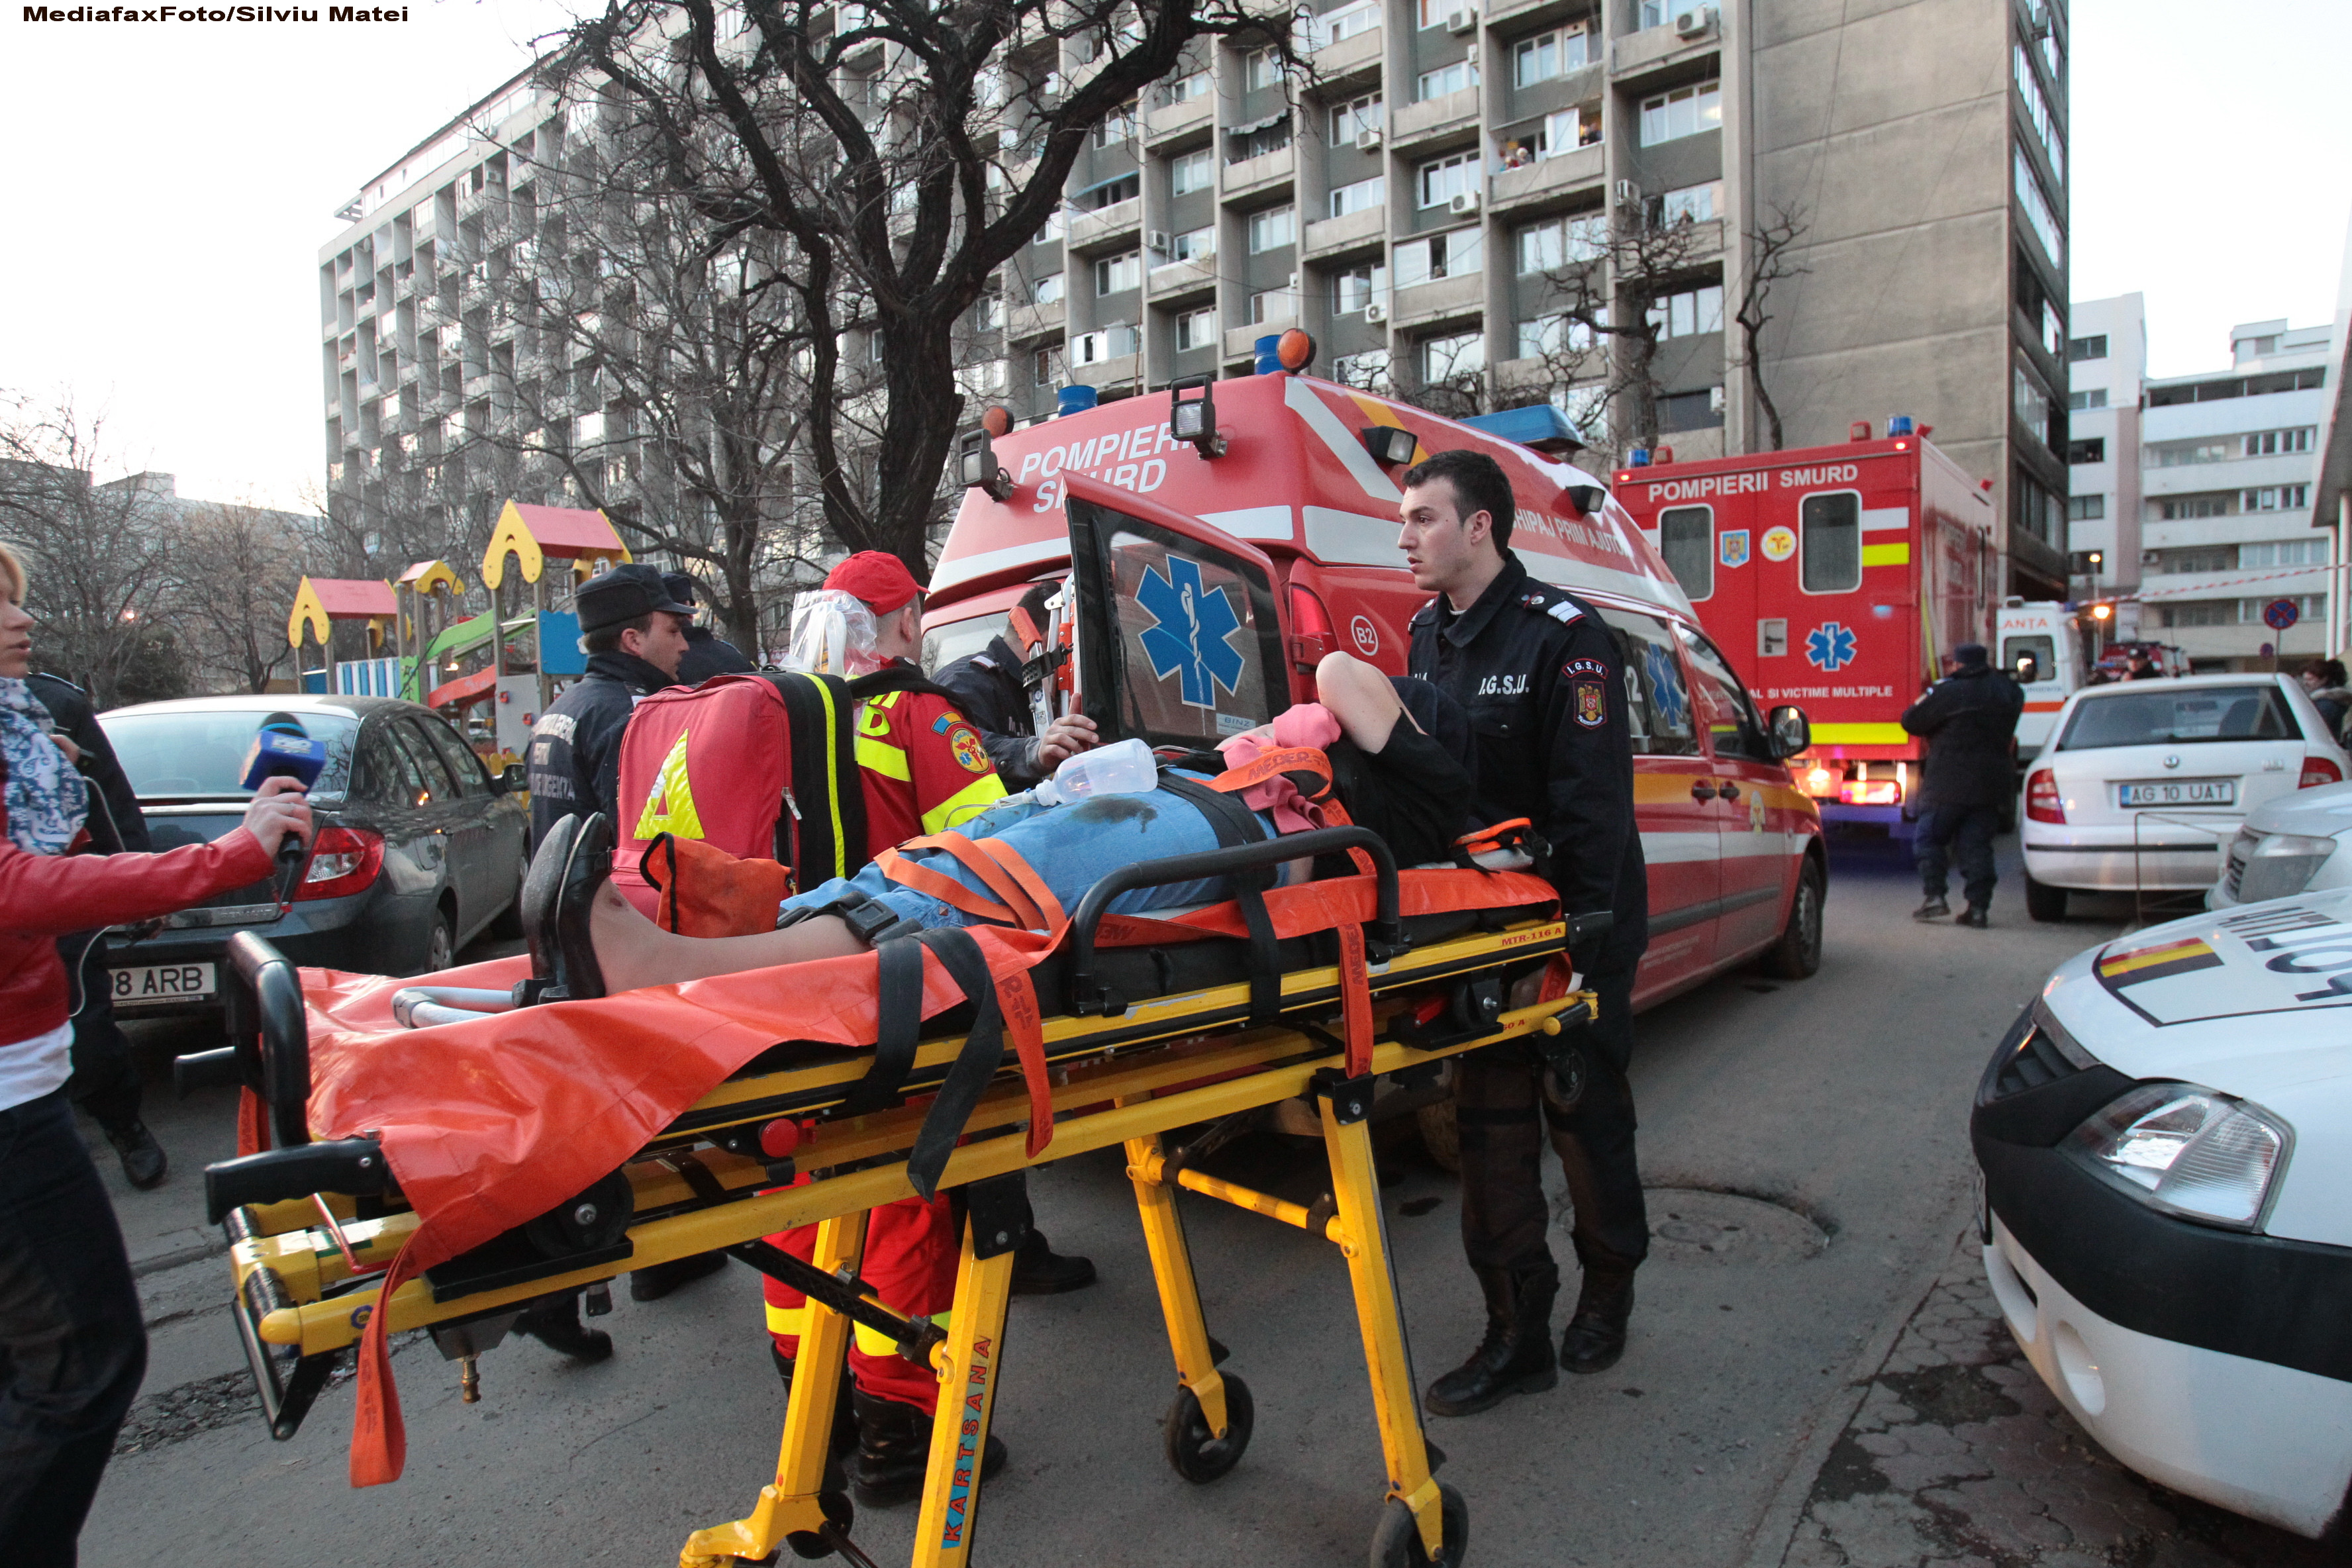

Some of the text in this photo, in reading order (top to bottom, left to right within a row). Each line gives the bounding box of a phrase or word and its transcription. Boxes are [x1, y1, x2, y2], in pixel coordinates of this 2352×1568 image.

[1018, 421, 1195, 485] POMPIER
[1033, 458, 1167, 513] SRD
[1648, 464, 1859, 503] POMPIERII SMURD
[1554, 517, 1589, 546] PRIM
[1588, 528, 1632, 558] AJUTO
[1355, 626, 1375, 644] B2
[1478, 674, 1530, 695] I.G.S.U.
[1781, 687, 1830, 699] VICTIME
[1833, 685, 1894, 697] MULTIPLE
[1224, 716, 1250, 727] BINZ
[2132, 784, 2226, 803] AG 10 UAT
[1501, 932, 1551, 947] MTR-116
[142, 966, 203, 995] ARB
[944, 1335, 992, 1542] KARTSANA
